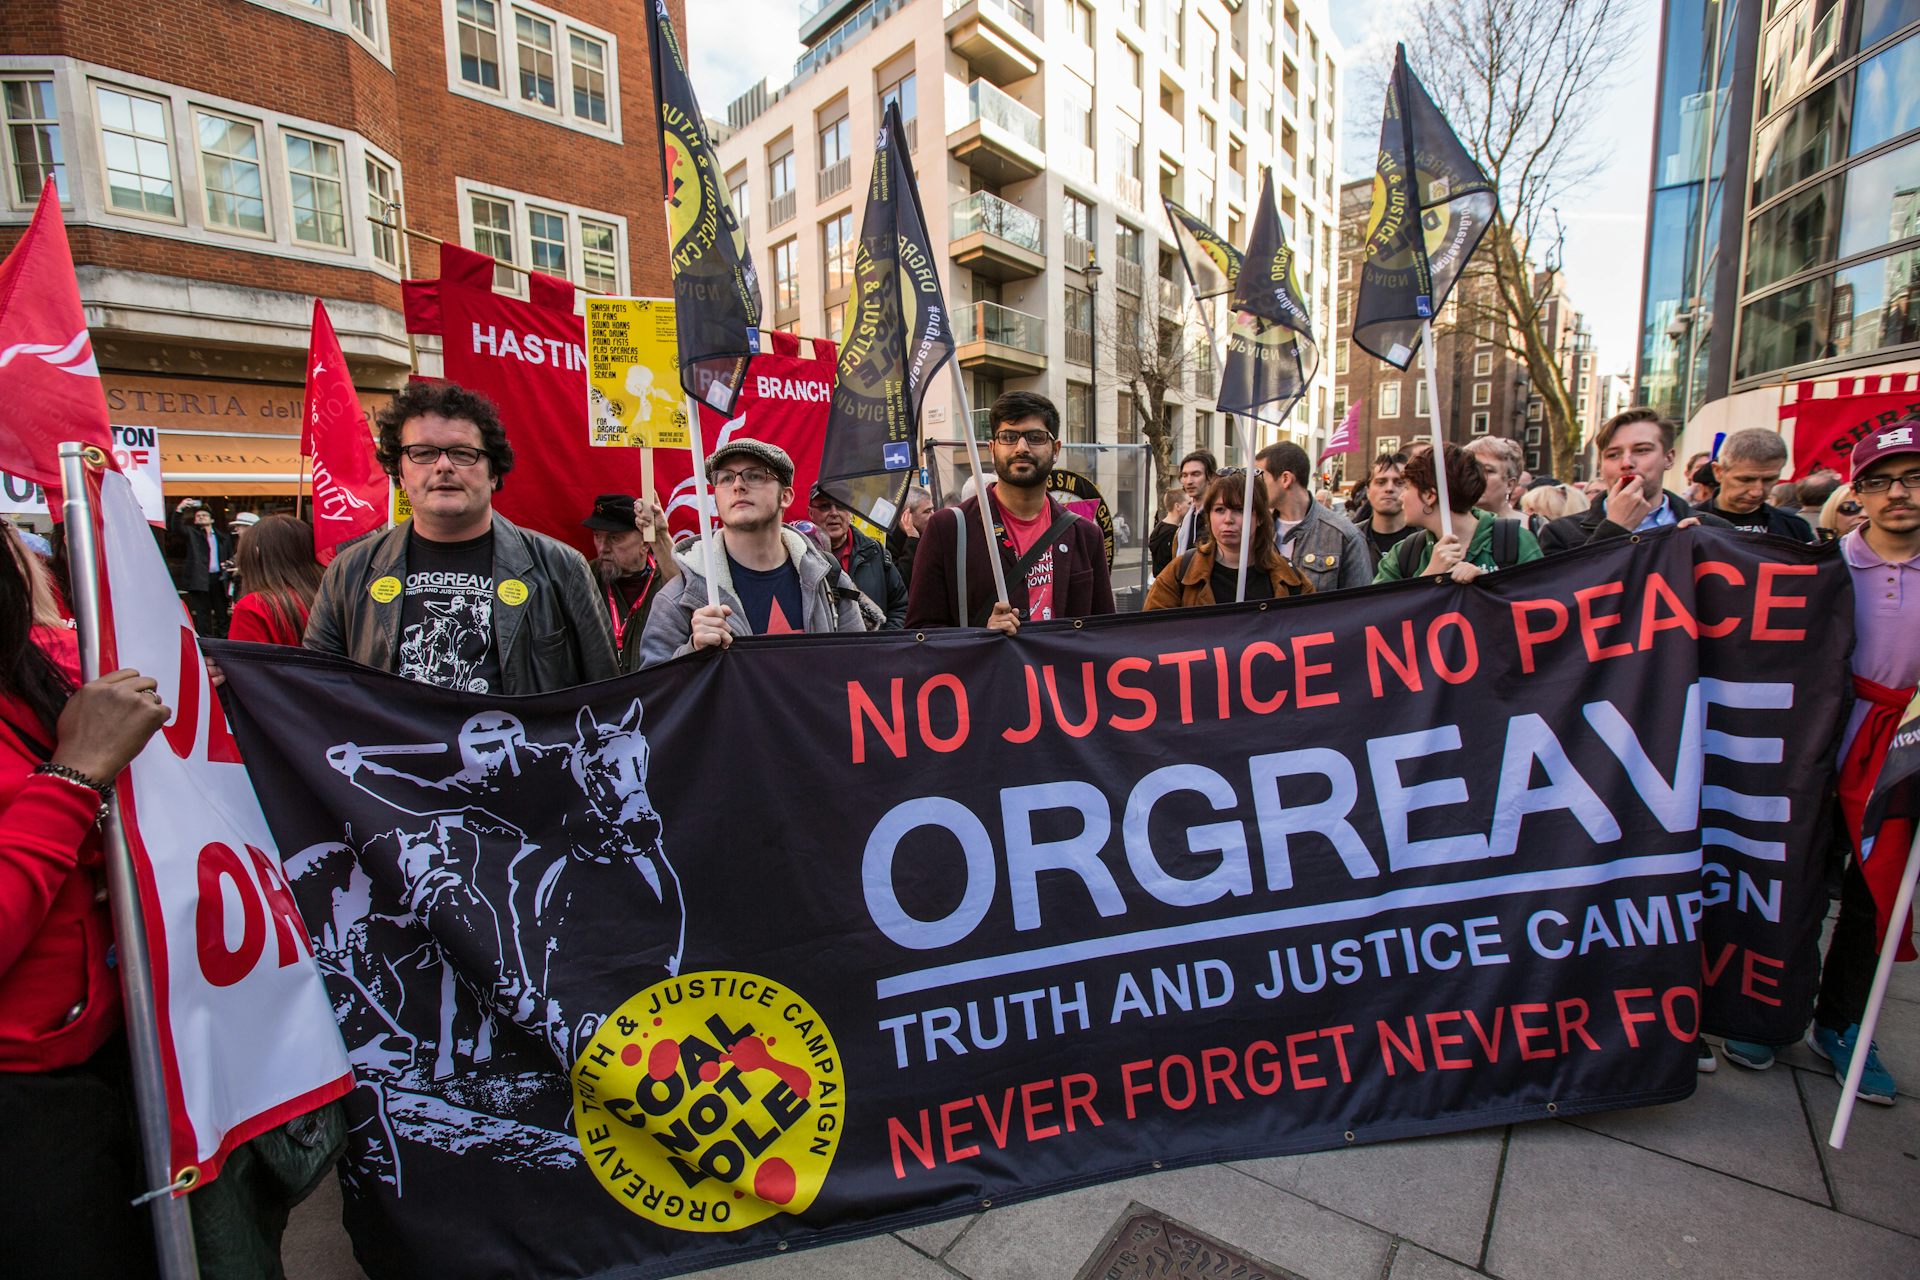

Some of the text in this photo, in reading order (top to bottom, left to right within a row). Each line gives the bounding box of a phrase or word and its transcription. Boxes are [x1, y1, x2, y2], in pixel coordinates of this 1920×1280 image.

[697, 155, 709, 168] &
[1388, 174, 1402, 189] &
[696, 175, 717, 250] JUSTICE
[1375, 188, 1405, 245] JUSTICE
[863, 281, 880, 294] &
[591, 303, 610, 312] SMASH
[612, 304, 627, 313] POTS
[591, 312, 602, 320] HIT
[591, 321, 610, 329] SOUND
[609, 330, 628, 338] DRUMS
[839, 300, 880, 377] JUSTICE
[592, 338, 629, 346] POUND FISTS
[593, 346, 638, 355] PLAY SPEAKERS
[594, 354, 638, 363] BLOW WHISTLES
[594, 371, 617, 379] SCREAM
[756, 374, 831, 403] BRANCH
[108, 388, 247, 417] STERIA
[596, 417, 607, 425] FOR
[597, 425, 628, 434] ORGREAVE
[595, 434, 621, 442] JUSTICE
[1097, 504, 1113, 532] GAY
[405, 587, 424, 596] TRUTH
[439, 587, 466, 596] JUSTICE
[846, 561, 1819, 764] NO JUSTICE NO PEACE
[861, 676, 1795, 950] ORGREAVE
[878, 980, 1091, 1070] TRUTH
[1110, 958, 1236, 1025] AND
[1254, 914, 1511, 1000] JUSTICE
[603, 1012, 756, 1128] COAL
[887, 1072, 1105, 1180] NEVER
[1121, 1023, 1356, 1120] FORGET
[1376, 996, 1602, 1077] NEVER
[576, 977, 838, 1223] ORGREAVE TRUTH & JUSTICE CAMPAIGN
[651, 1065, 752, 1156] NOT
[666, 1080, 812, 1189] DOLE
